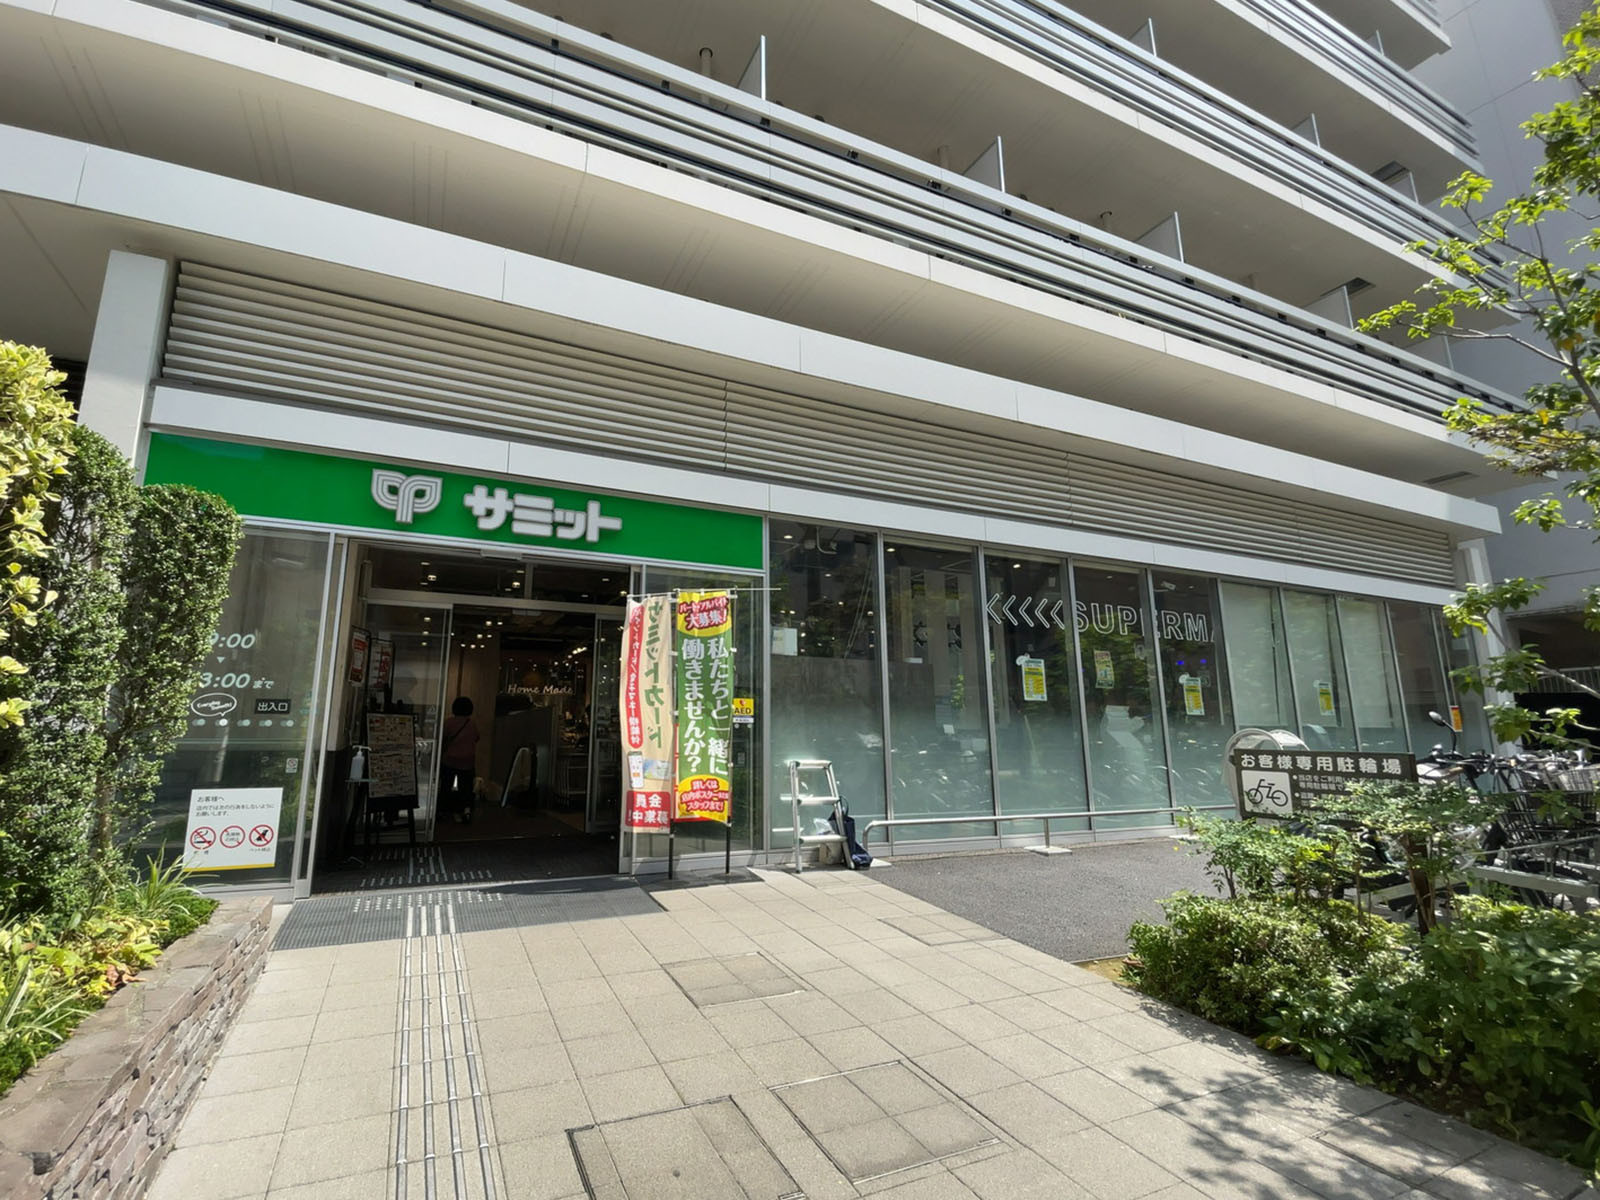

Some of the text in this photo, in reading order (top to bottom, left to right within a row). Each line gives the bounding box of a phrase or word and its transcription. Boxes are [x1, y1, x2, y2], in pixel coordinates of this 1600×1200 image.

[464, 484, 622, 543] サミット
[1075, 600, 1215, 642] SUPRM
[507, 684, 573, 695] Home Made
[682, 638, 706, 773] 働きませんか?
[257, 702, 288, 712] 出入口
[707, 638, 730, 775] 私たちと一緒に
[734, 707, 752, 715] AED
[1241, 753, 1402, 775] お客様専用駐輪場
